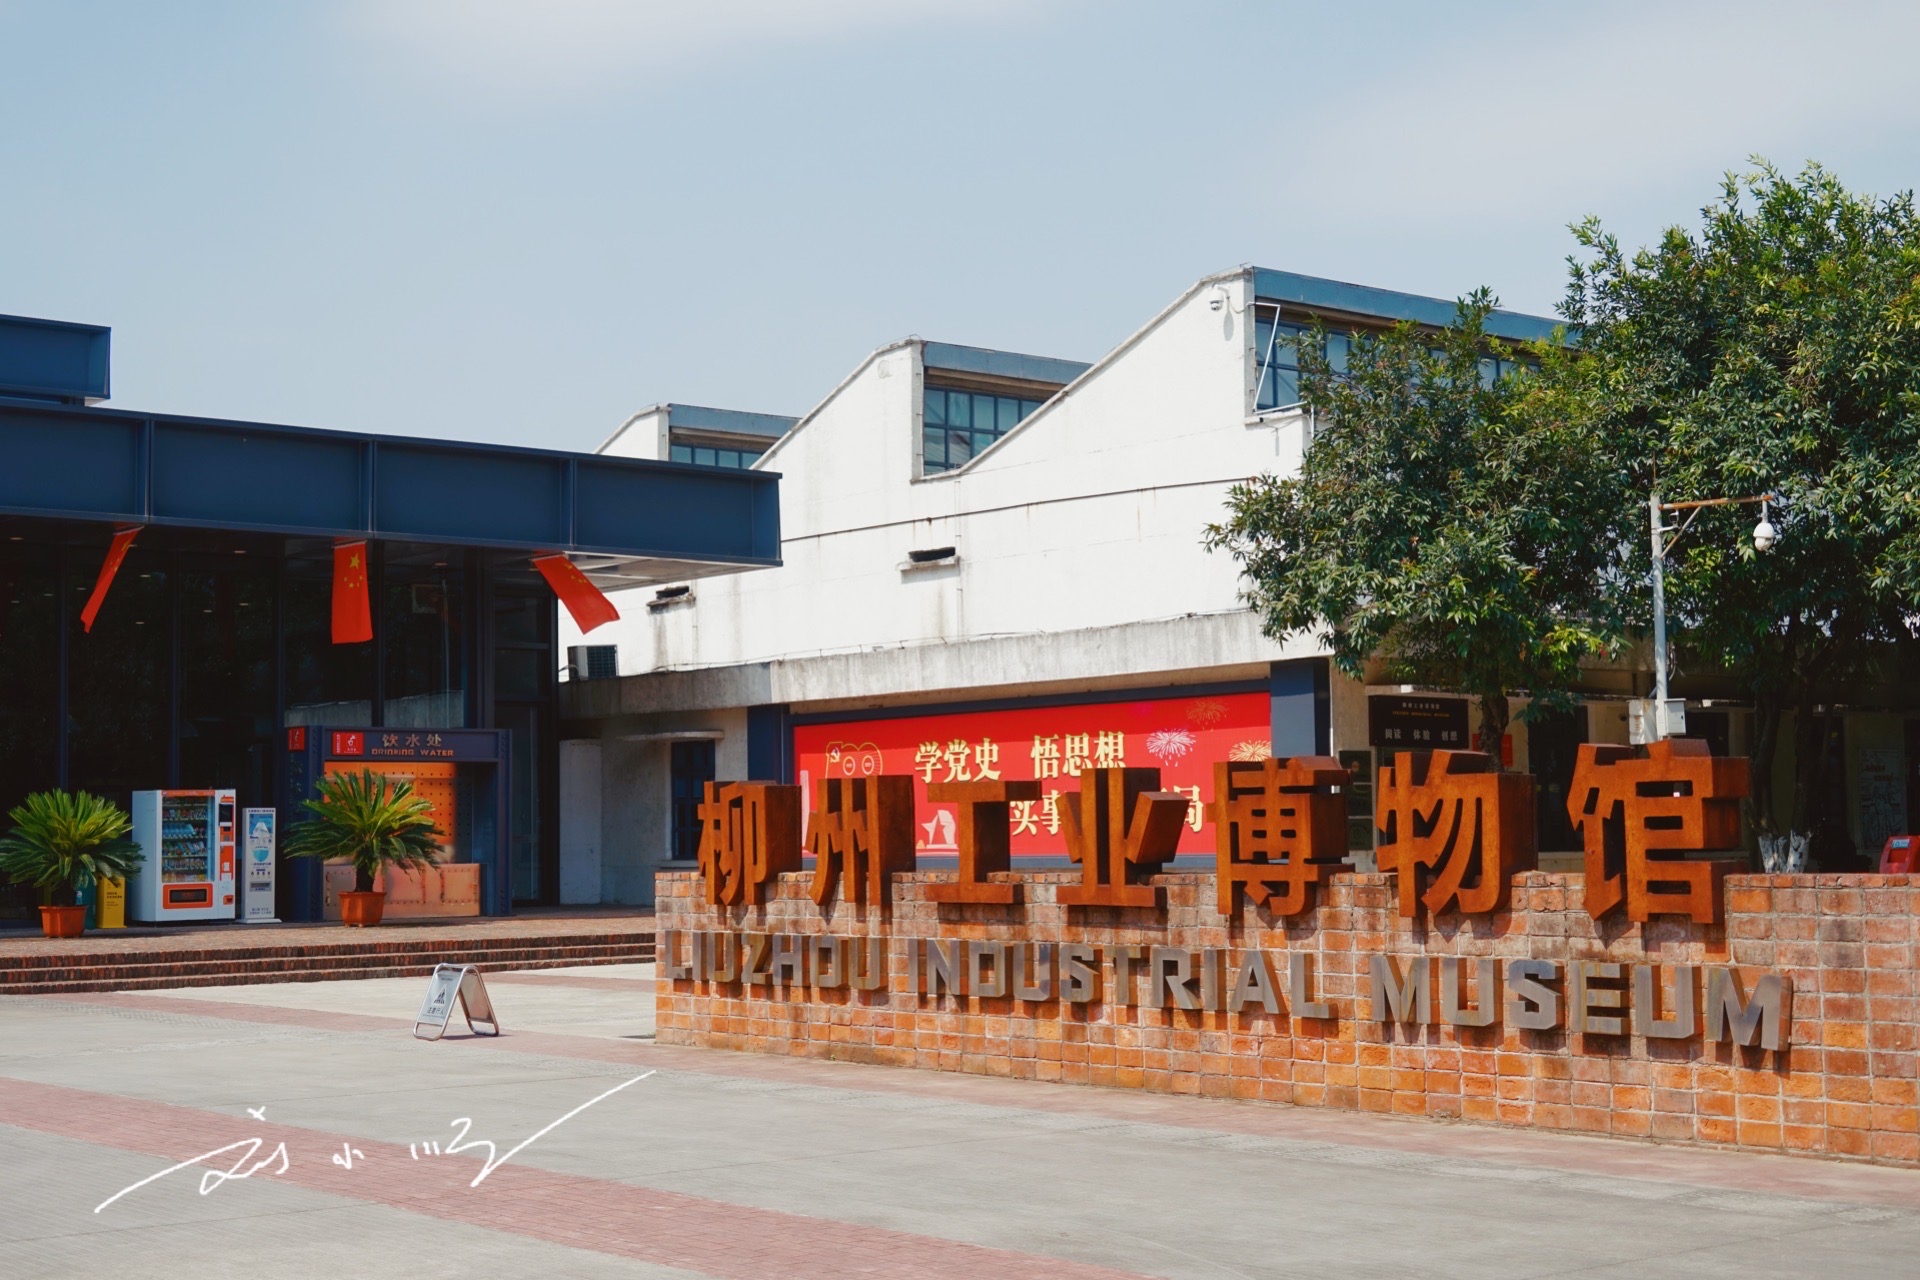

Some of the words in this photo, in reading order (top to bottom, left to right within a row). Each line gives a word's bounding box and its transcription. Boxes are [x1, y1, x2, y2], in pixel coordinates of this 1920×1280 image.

[382, 734, 442, 747] 饮水处
[1385, 728, 1401, 740] 阅读
[1413, 729, 1430, 740] 体验
[371, 748, 415, 756] DRINKING
[420, 749, 455, 757] WATER
[914, 737, 1002, 783] 学党史
[1030, 730, 1127, 779] 悟思想
[697, 739, 1740, 924] 柳州工业博物馆
[664, 930, 885, 991] LIUZHOU
[907, 938, 1340, 1019] INDUSTRIAL
[1370, 955, 1793, 1052] MUSEUM
